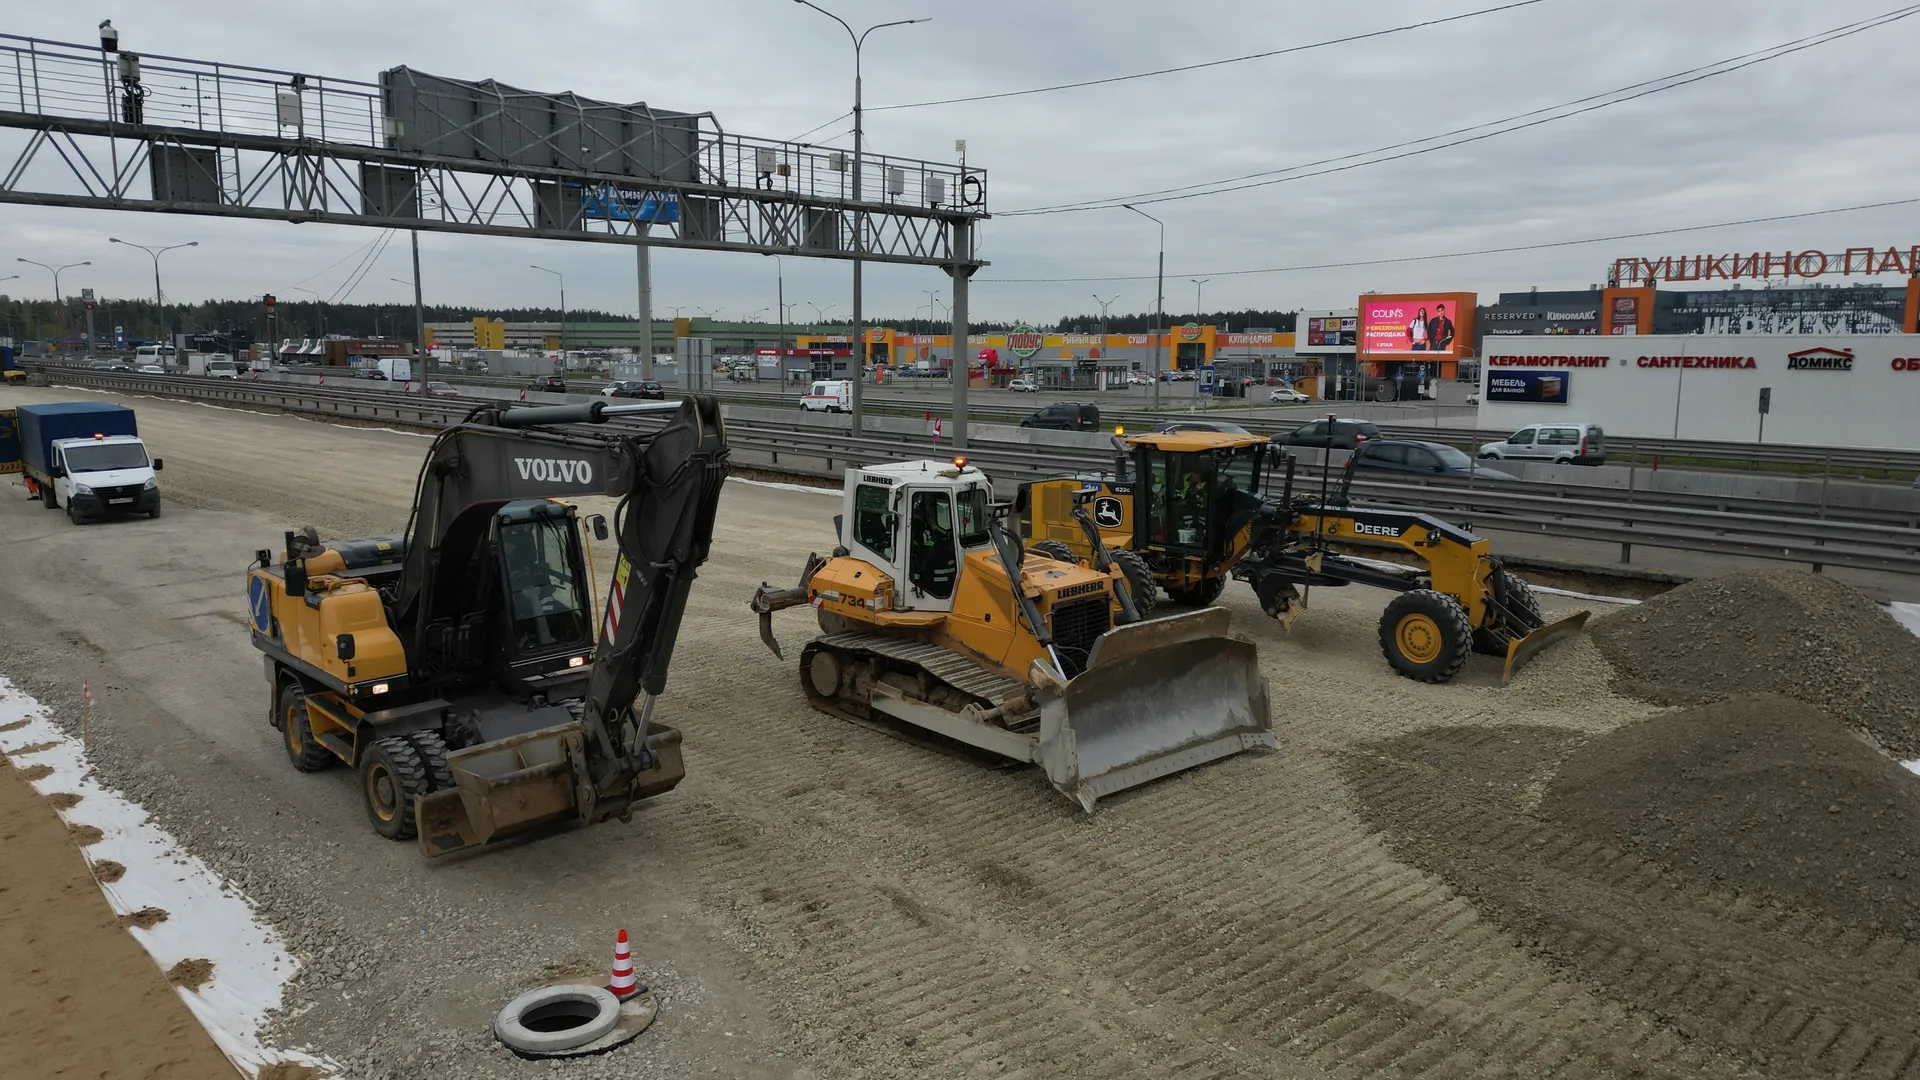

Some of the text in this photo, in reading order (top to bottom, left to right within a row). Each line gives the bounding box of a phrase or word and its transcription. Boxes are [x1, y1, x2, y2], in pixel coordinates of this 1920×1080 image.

[1615, 249, 1828, 282] ПУШКИНО
[1372, 308, 1403, 318] COLIN'S
[1484, 312, 1535, 320] RESERVED
[1547, 310, 1596, 321] КИНОМАКС
[1062, 335, 1102, 345] РЫБНЫЙ ЦЕХ
[1128, 335, 1147, 344] СУШИ
[1228, 335, 1273, 344] КУЛИНАРИЯ
[1489, 355, 1757, 369] КЕРАМОГРАНИТ САНТЕХНИКА
[1787, 357, 1853, 370] ДОМИКС
[1491, 378, 1526, 387] МЕБЕЛЬ
[514, 458, 592, 484] VOLVO
[863, 474, 893, 486] LIEBHERR
[1354, 521, 1400, 537] DEERE
[1057, 580, 1105, 600] LIEBHERR
[839, 593, 866, 609] 734
